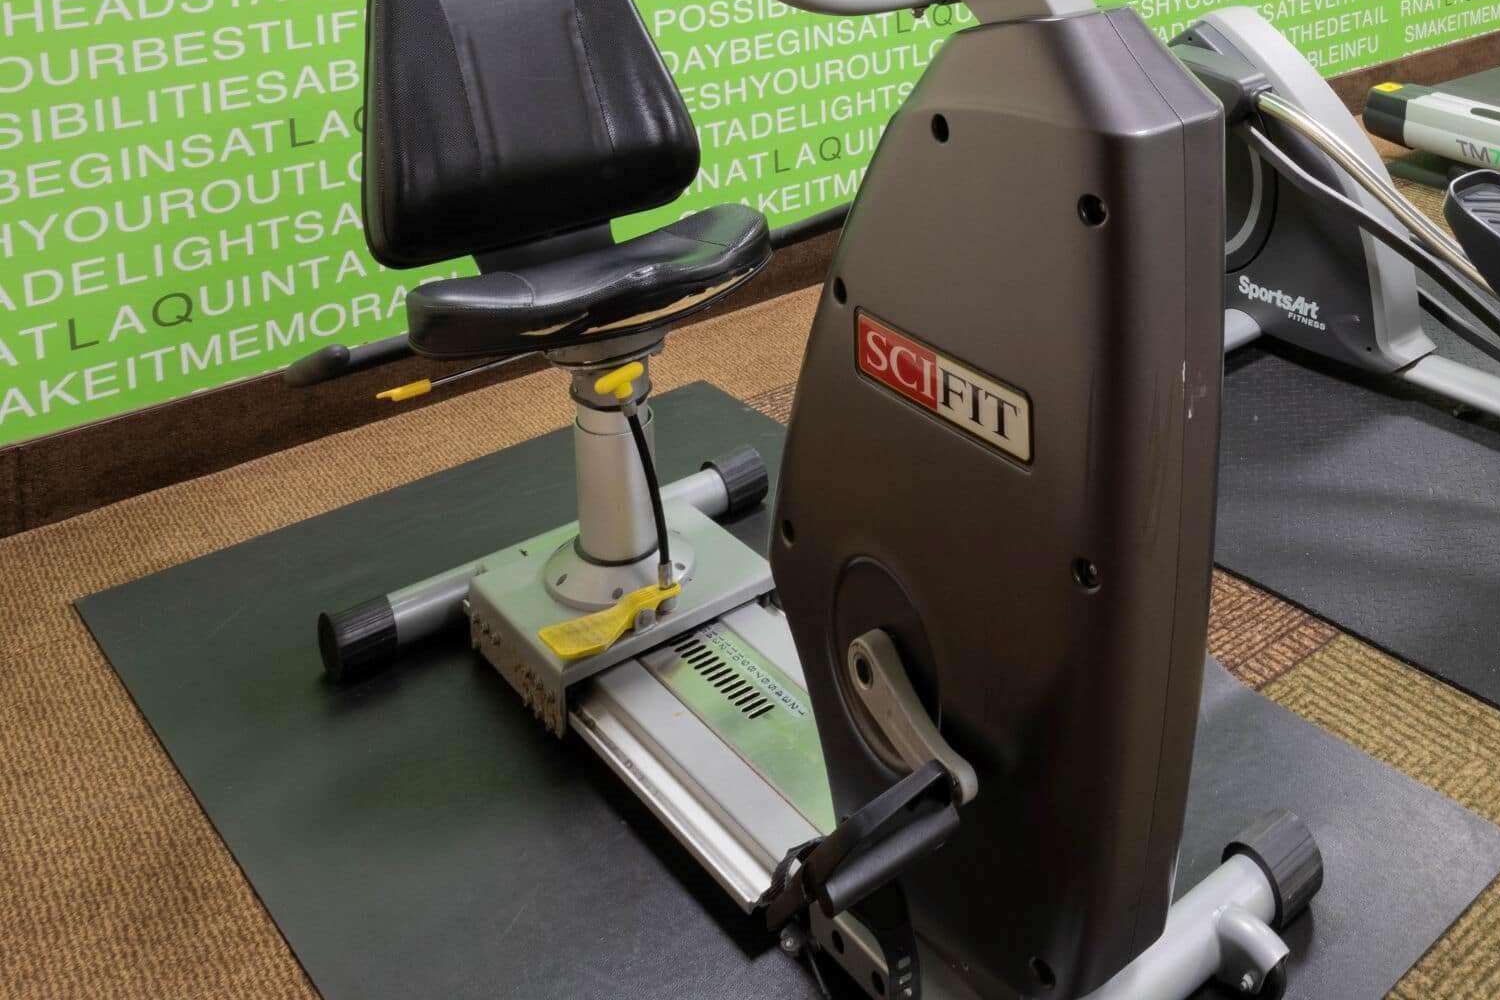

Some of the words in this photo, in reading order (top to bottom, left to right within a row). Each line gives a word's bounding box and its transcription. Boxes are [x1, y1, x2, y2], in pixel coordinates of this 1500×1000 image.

[0, 7, 367, 93] OURBESTLIF
[0, 248, 386, 367] TLAQUINTA
[1238, 274, 1320, 320] SportsArt
[1287, 311, 1326, 331] FITNESS
[0, 271, 458, 425] AKEITMEMORA
